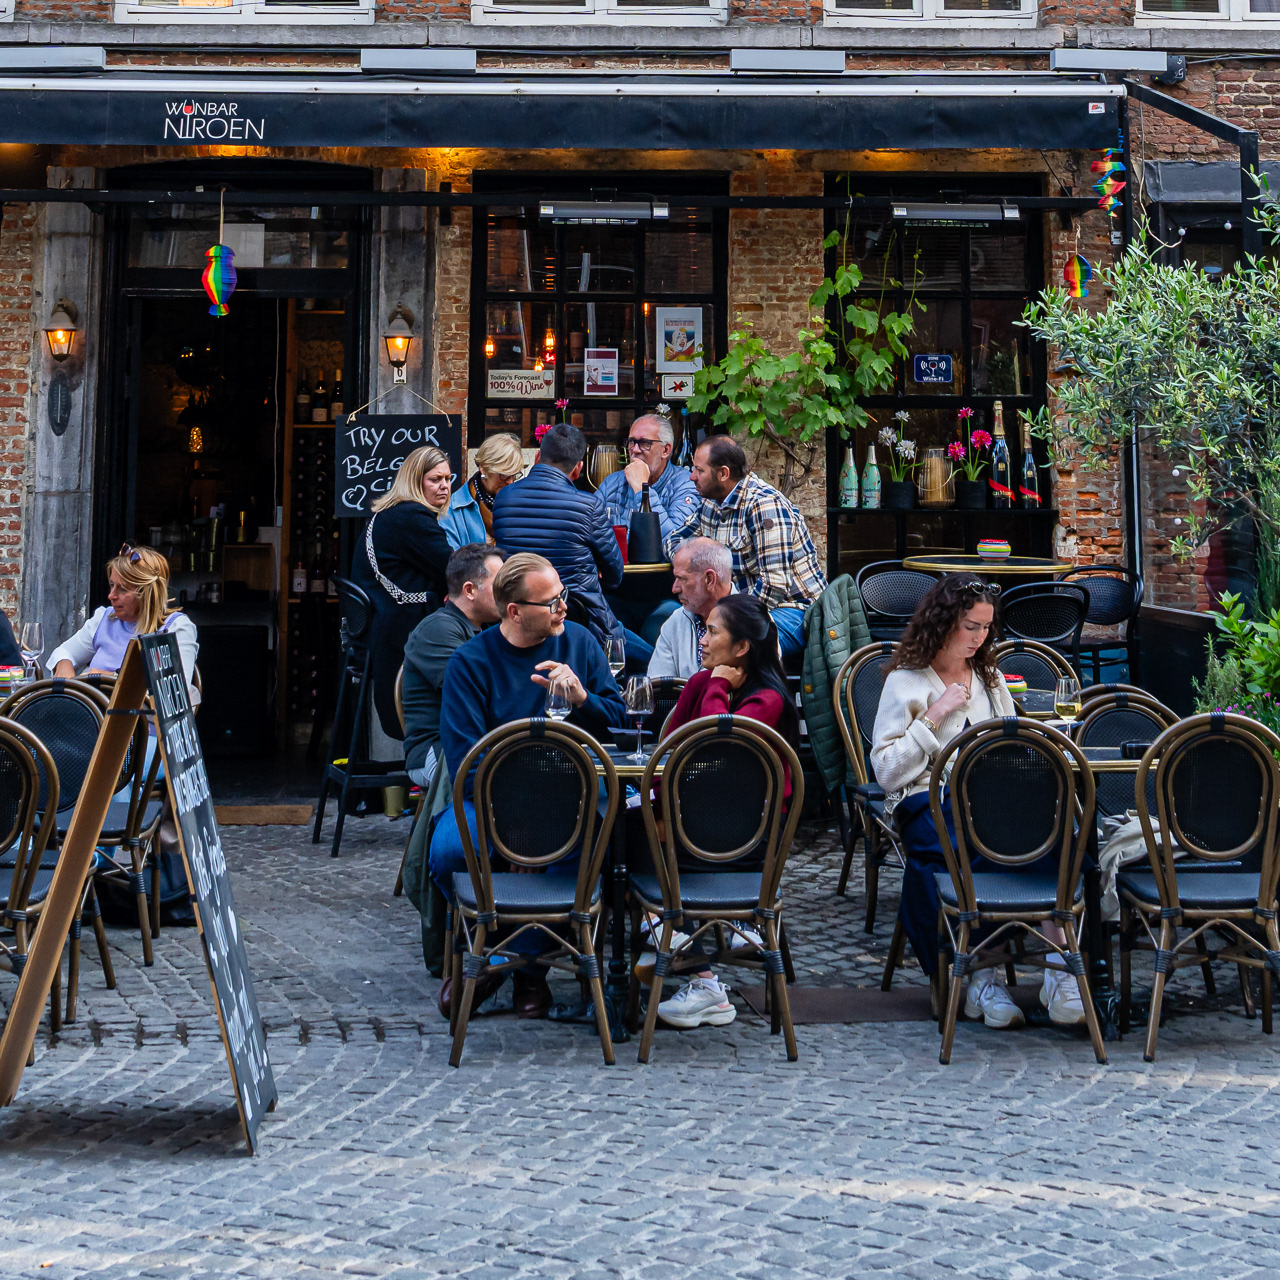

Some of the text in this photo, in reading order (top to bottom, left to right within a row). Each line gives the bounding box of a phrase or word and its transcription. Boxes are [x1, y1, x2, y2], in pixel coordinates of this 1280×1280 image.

[164, 118, 264, 139] NIROEN
[489, 380, 545, 395] 100% Wine
[345, 425, 440, 457] TRY OUR
[342, 455, 408, 479] BELG
